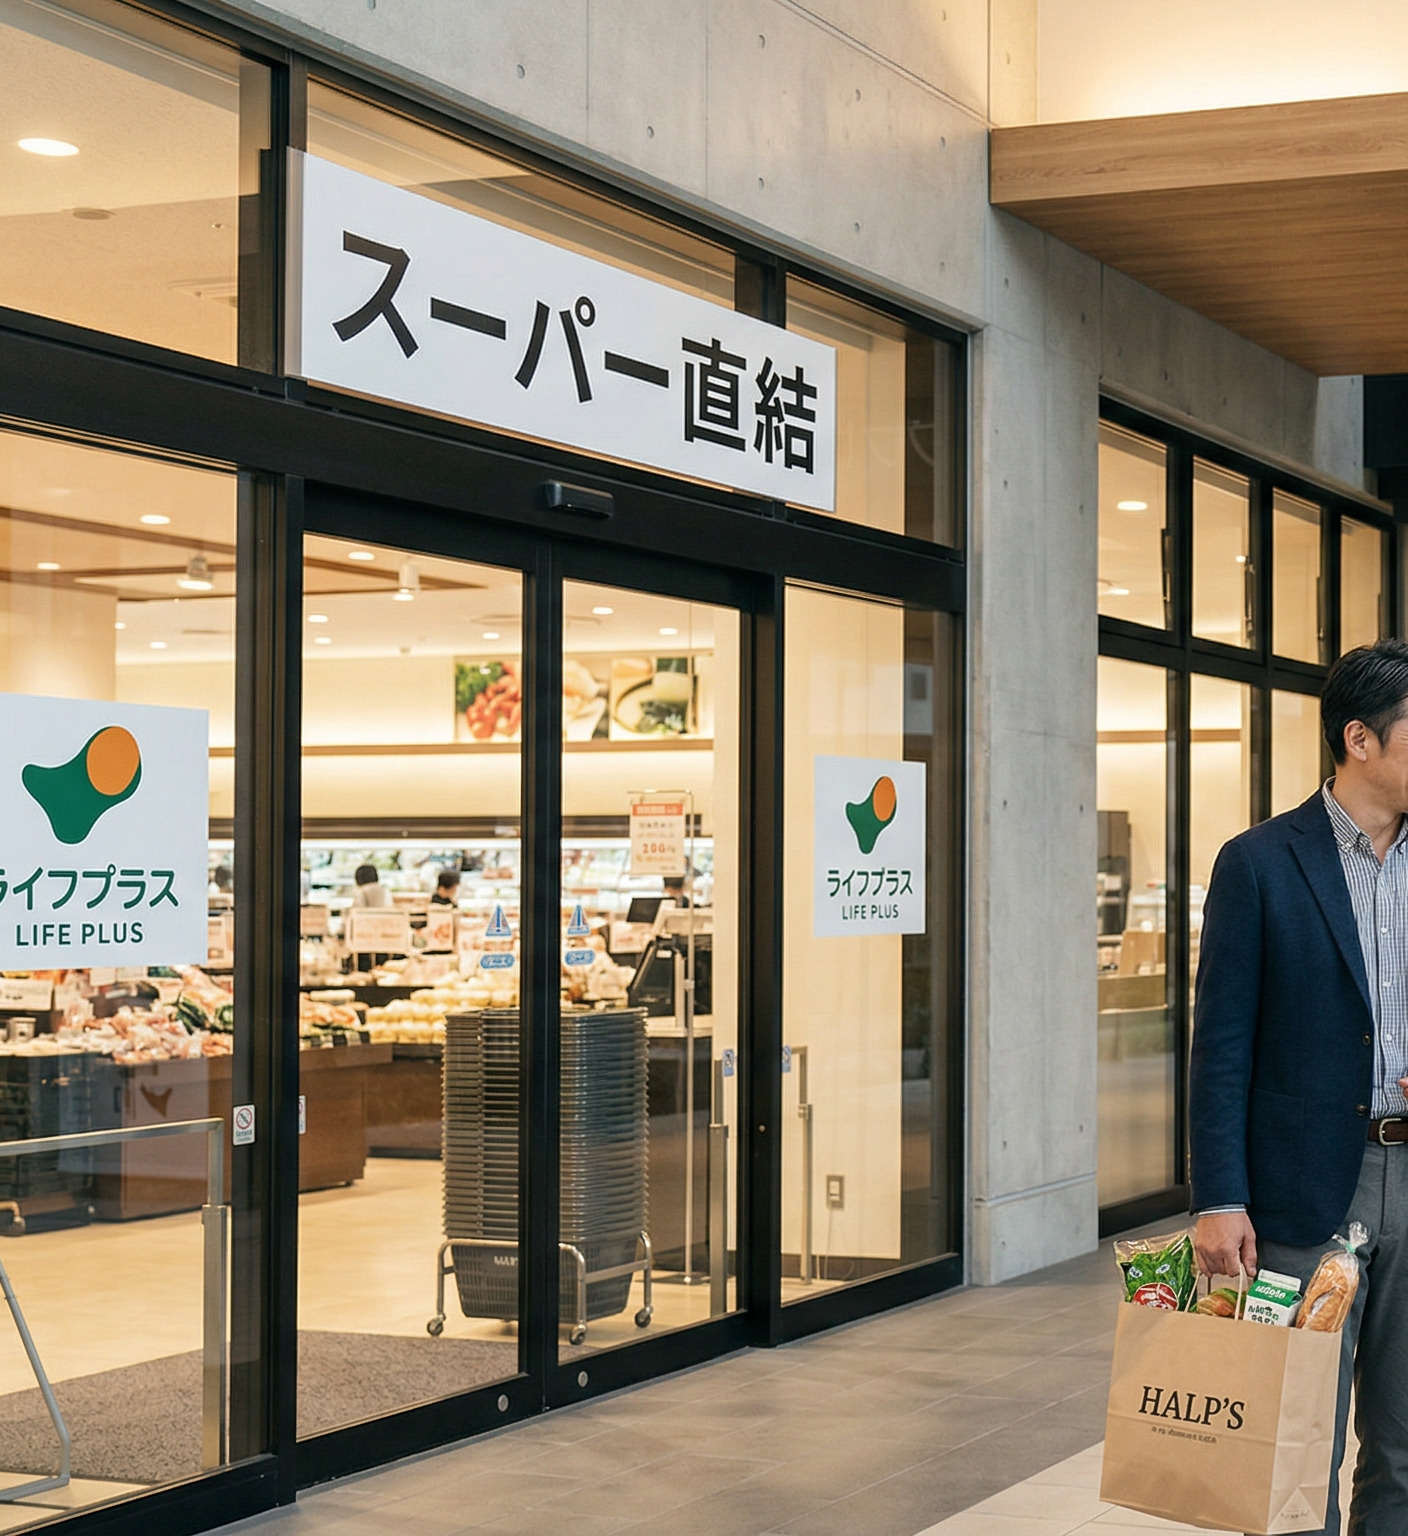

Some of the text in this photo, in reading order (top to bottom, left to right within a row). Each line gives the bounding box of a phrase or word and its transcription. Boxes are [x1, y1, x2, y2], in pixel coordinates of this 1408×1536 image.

[332, 229, 818, 475] スーパー直結
[0, 863, 179, 910] イフプラス
[827, 867, 913, 897] ライフプラス
[842, 904, 899, 920] LIFE PLUS
[16, 922, 143, 946] LIFE PLUS
[1138, 1385, 1246, 1431] HALP'S
